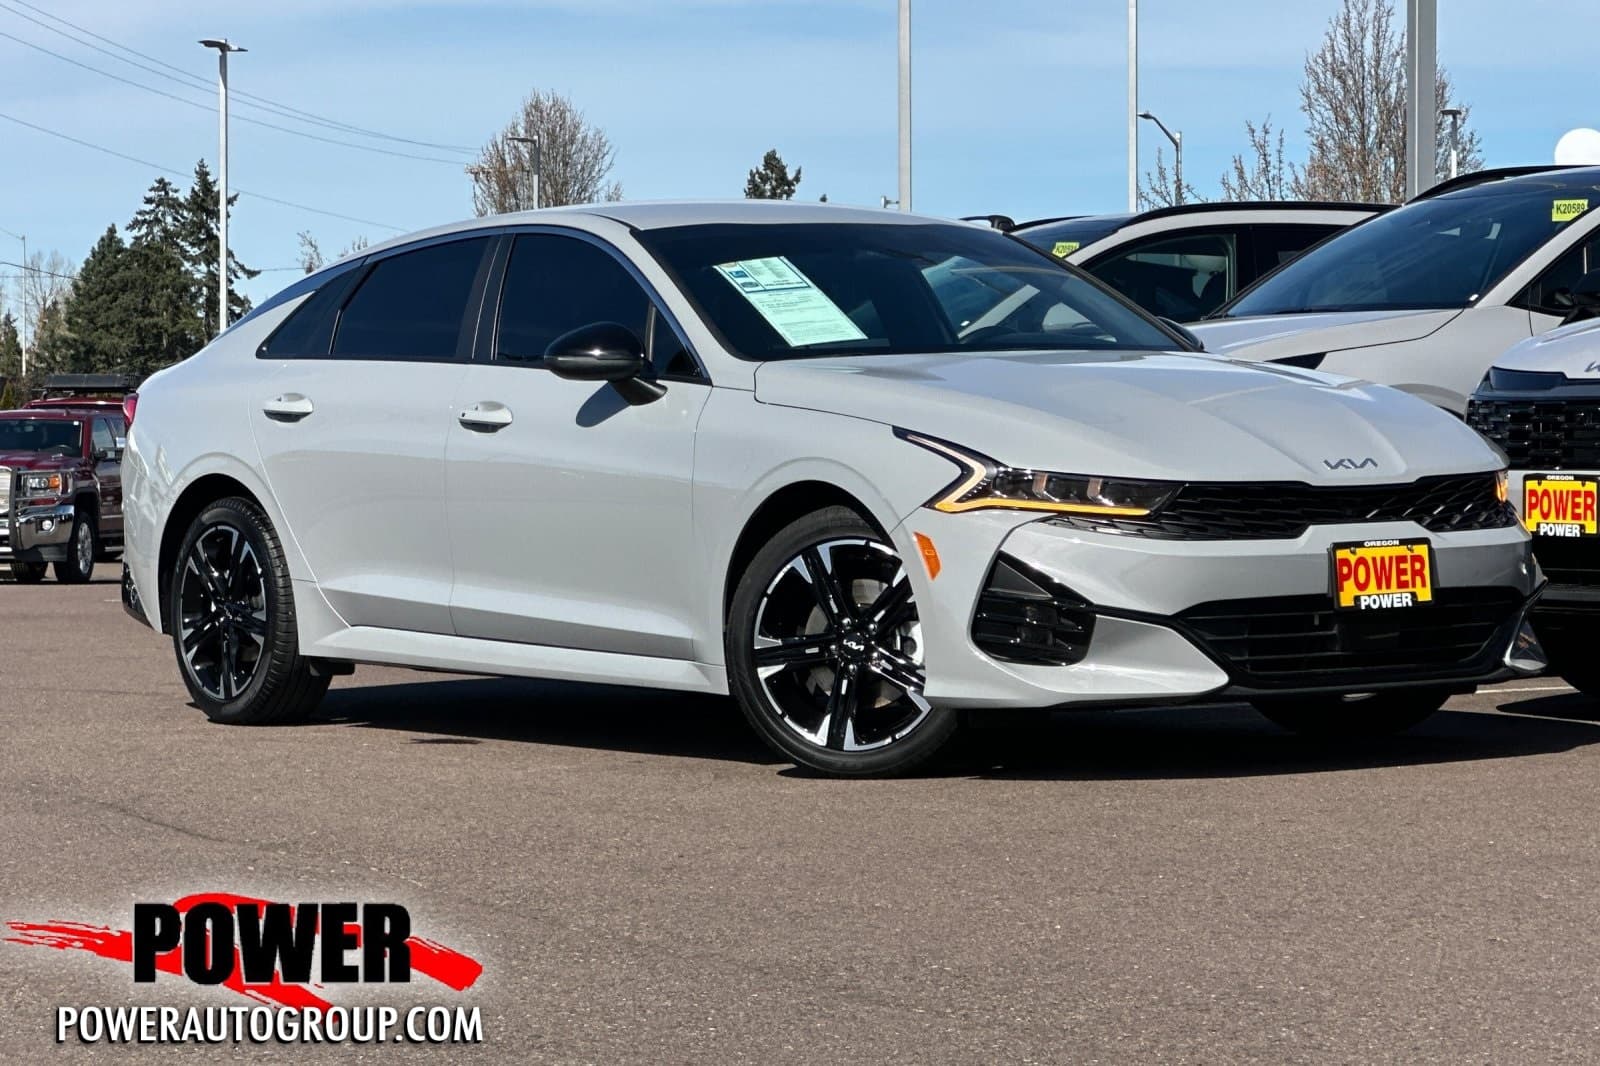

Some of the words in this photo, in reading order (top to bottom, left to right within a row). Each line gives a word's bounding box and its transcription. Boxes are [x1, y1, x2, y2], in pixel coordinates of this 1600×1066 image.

[1323, 457, 1378, 470] KIA
[1527, 488, 1596, 522] POWER
[1539, 523, 1581, 538] POWER
[1363, 539, 1400, 547] OREGON
[1337, 554, 1427, 593] POWER
[1360, 592, 1413, 610] POWER
